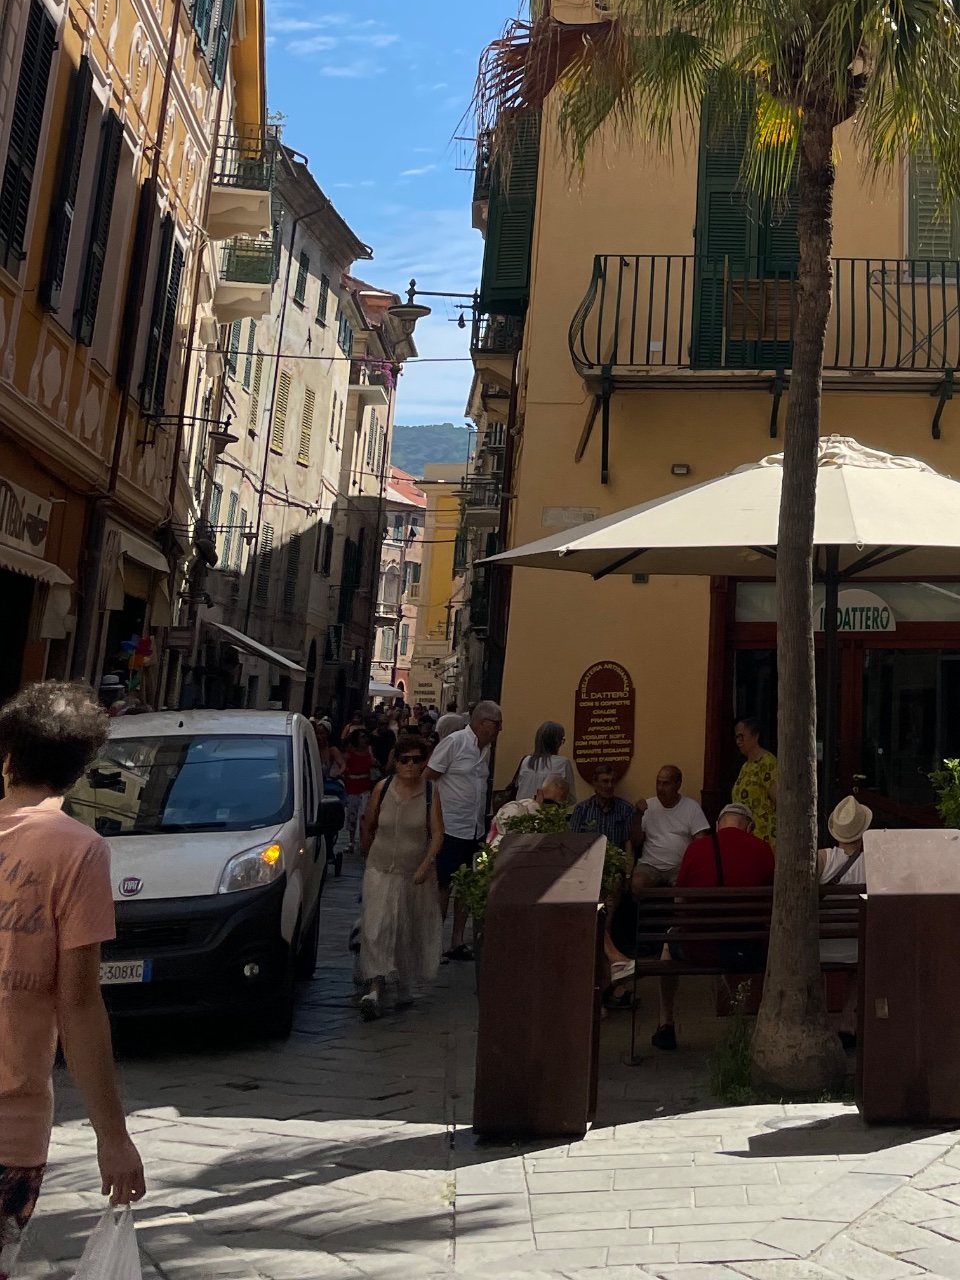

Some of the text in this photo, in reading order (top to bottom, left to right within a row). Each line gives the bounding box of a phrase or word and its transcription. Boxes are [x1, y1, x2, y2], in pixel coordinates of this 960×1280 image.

[836, 606, 890, 630] DATTERO
[590, 691, 629, 699] DATTERO
[124, 881, 138, 891] FIAT
